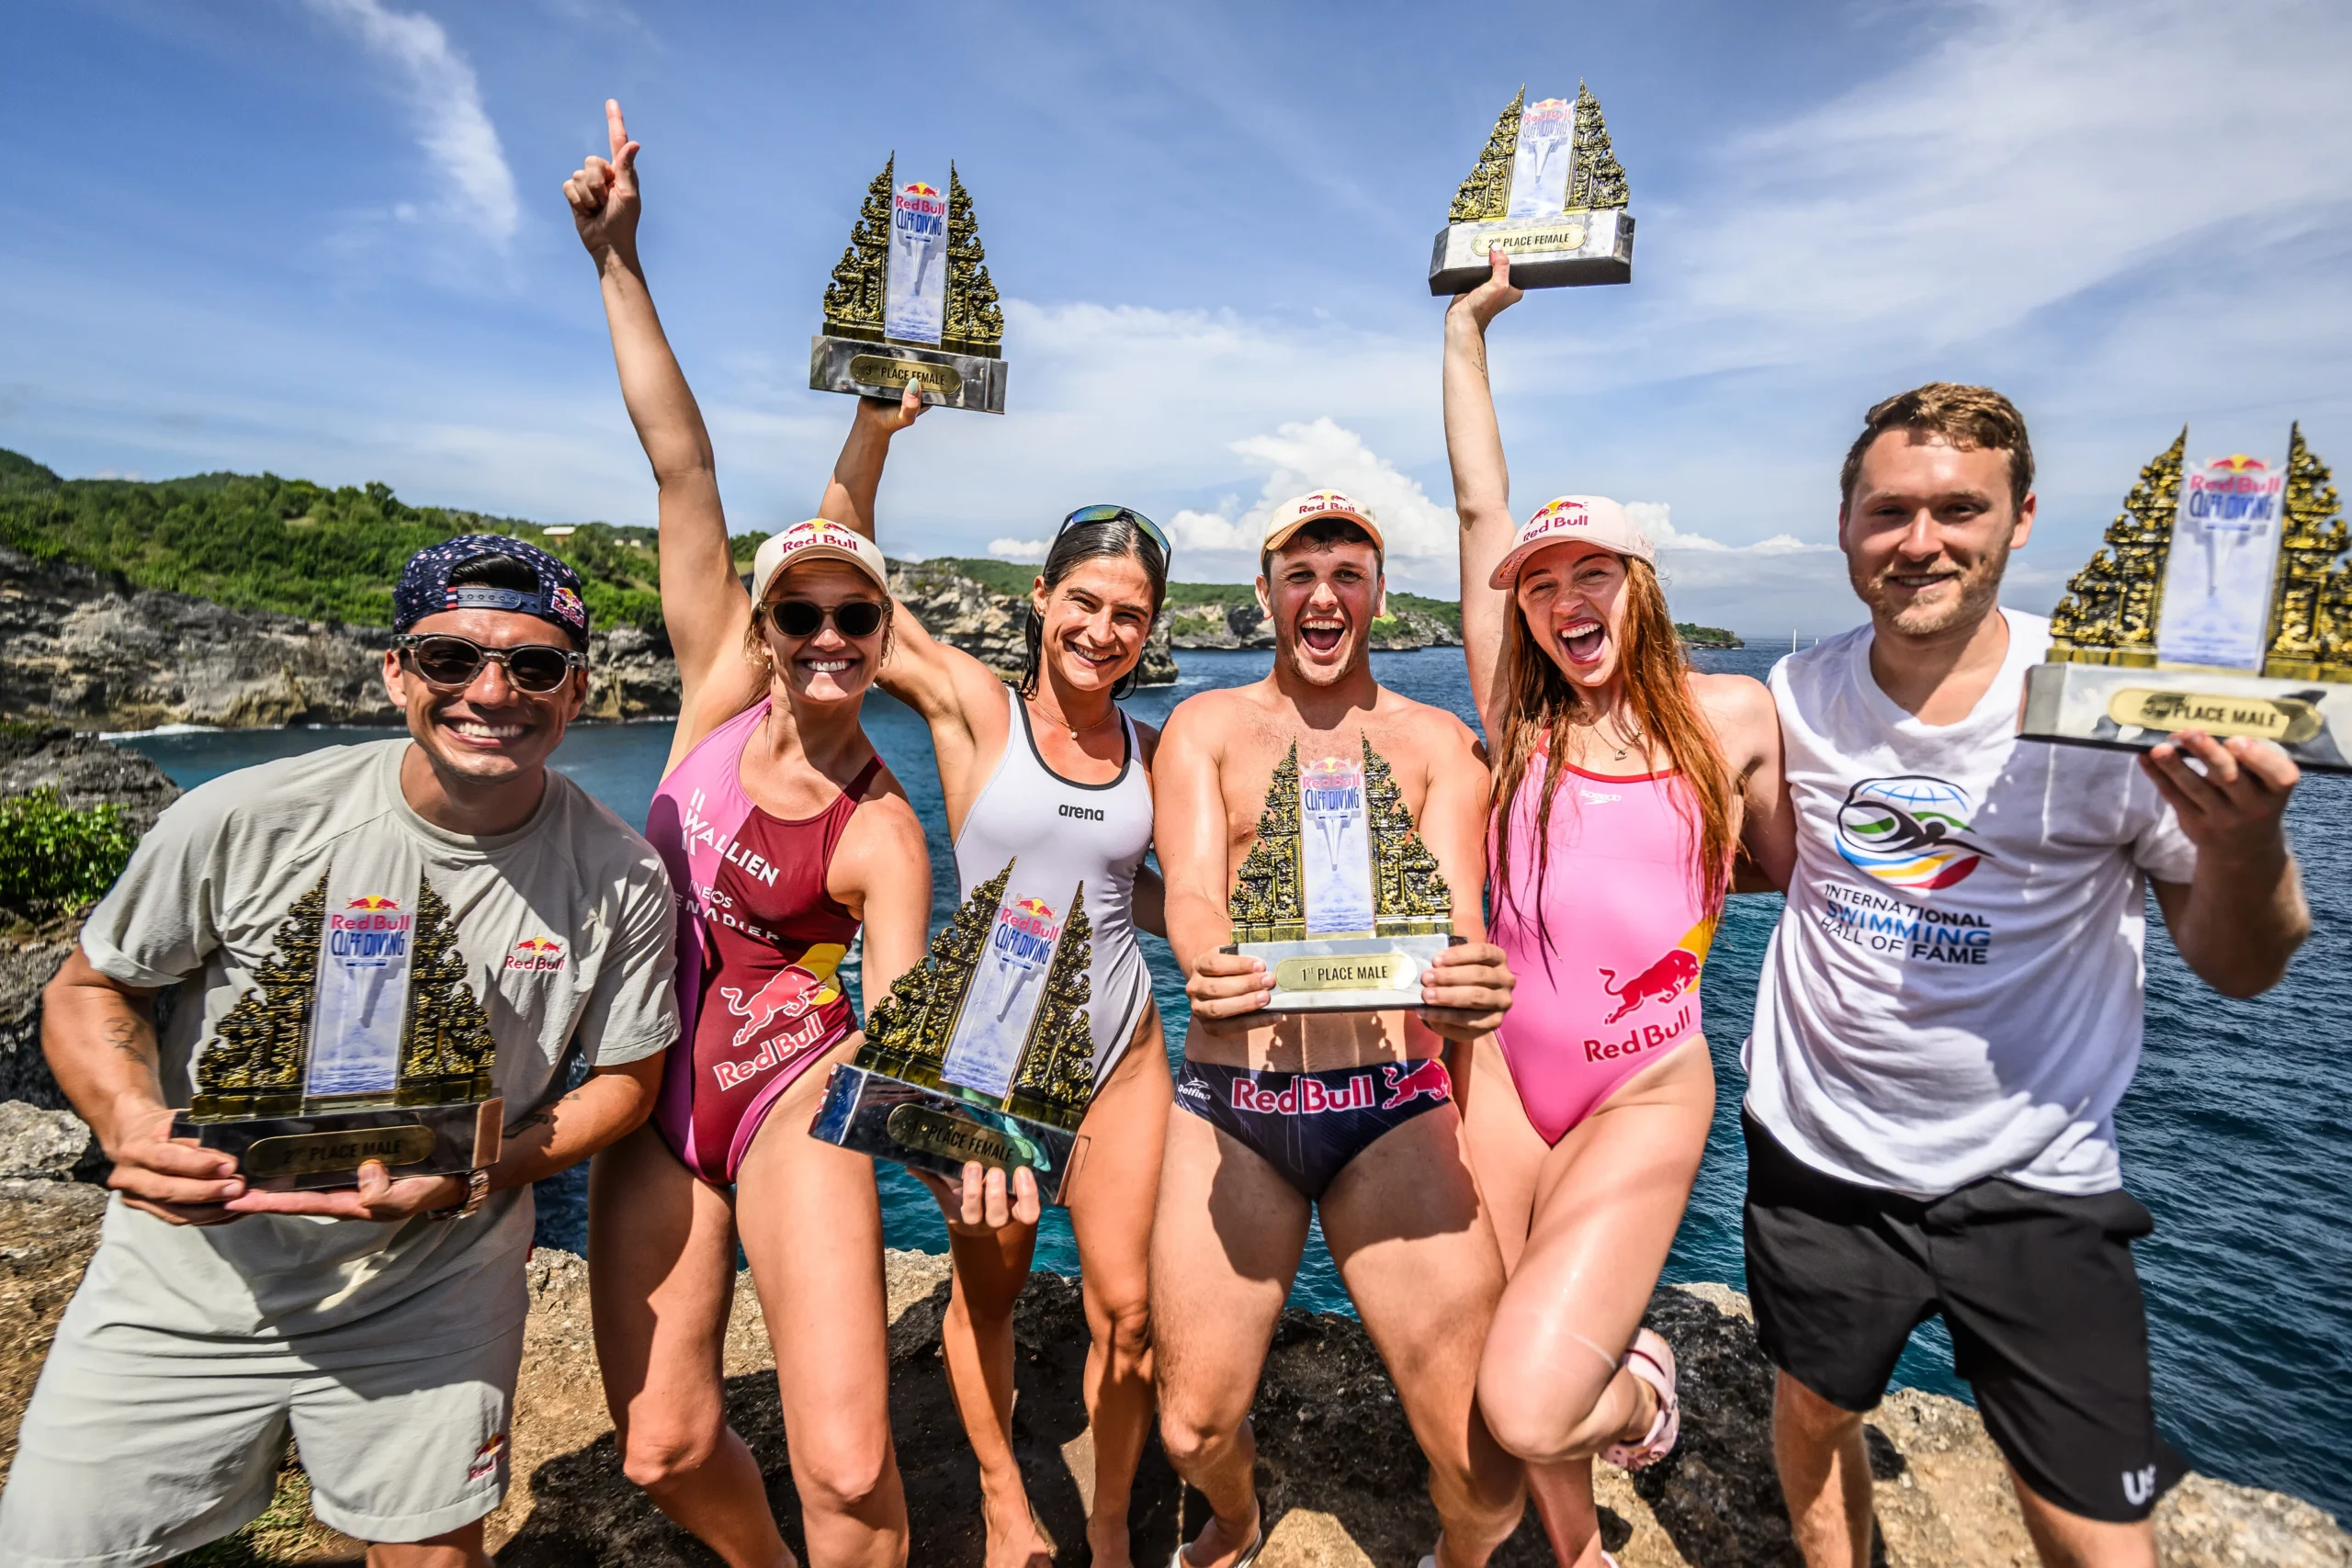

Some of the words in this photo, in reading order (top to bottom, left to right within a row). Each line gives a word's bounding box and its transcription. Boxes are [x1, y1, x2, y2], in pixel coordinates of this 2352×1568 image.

[1523, 110, 1548, 123] Red
[1548, 107, 1572, 120] Bull
[895, 195, 920, 211] Red
[922, 199, 945, 215] Bull
[896, 209, 915, 231] CLIFF
[916, 214, 943, 236] DIVING
[1503, 236, 1532, 247] PLACE
[1534, 232, 1570, 244] FEMALE
[881, 367, 910, 380] PLACE
[911, 370, 945, 386] FEMALE
[2189, 475, 2235, 492] Red
[2236, 476, 2281, 493] Bull
[1298, 502, 1325, 514] Red
[1522, 520, 1550, 542] Red
[1554, 515, 1589, 528] Bull
[783, 534, 818, 554] Red
[823, 534, 859, 553] Bull
[551, 595, 571, 617] Red
[570, 607, 584, 628] Bull
[2173, 701, 2225, 723] PLACE
[2232, 709, 2277, 727] MALE
[1303, 773, 1330, 789] Red
[1332, 773, 1360, 787] Bull
[1305, 789, 1326, 811] CLIFF
[1329, 786, 1360, 810] DIVING
[1058, 804, 1104, 821] arena
[683, 807, 780, 887] WALLIEN
[688, 879, 733, 908] INEOS
[1825, 884, 1992, 928] INTERNATIONAL
[331, 914, 371, 930] Red
[373, 914, 411, 931] Bull
[674, 891, 780, 941] ENADIER
[1000, 907, 1032, 931] Red
[1030, 919, 1059, 942] Bull
[1826, 900, 1992, 948] SWIMMING
[363, 931, 405, 956] DIVING
[995, 923, 1021, 953] CLIFF
[1017, 934, 1053, 965] DIVING
[1821, 917, 1863, 946] HALL
[1871, 935, 1905, 953] OF
[1911, 943, 1988, 965] FAME
[503, 955, 536, 970] Red
[536, 957, 566, 971] Bull
[1317, 967, 1353, 981] PLACE
[1357, 965, 1388, 979] MALE
[1583, 1030, 1642, 1063] Red
[1643, 1005, 1690, 1049] Bull
[713, 1039, 778, 1092] Red
[771, 1010, 825, 1061] Bull
[1178, 1084, 1211, 1100] Delfina
[1231, 1075, 1300, 1115] Red
[1301, 1075, 1376, 1113] Bull
[309, 1143, 359, 1161] PLACE
[363, 1139, 403, 1156] MALE
[927, 1124, 968, 1150] PLACE
[967, 1137, 1014, 1163] FEMALE
